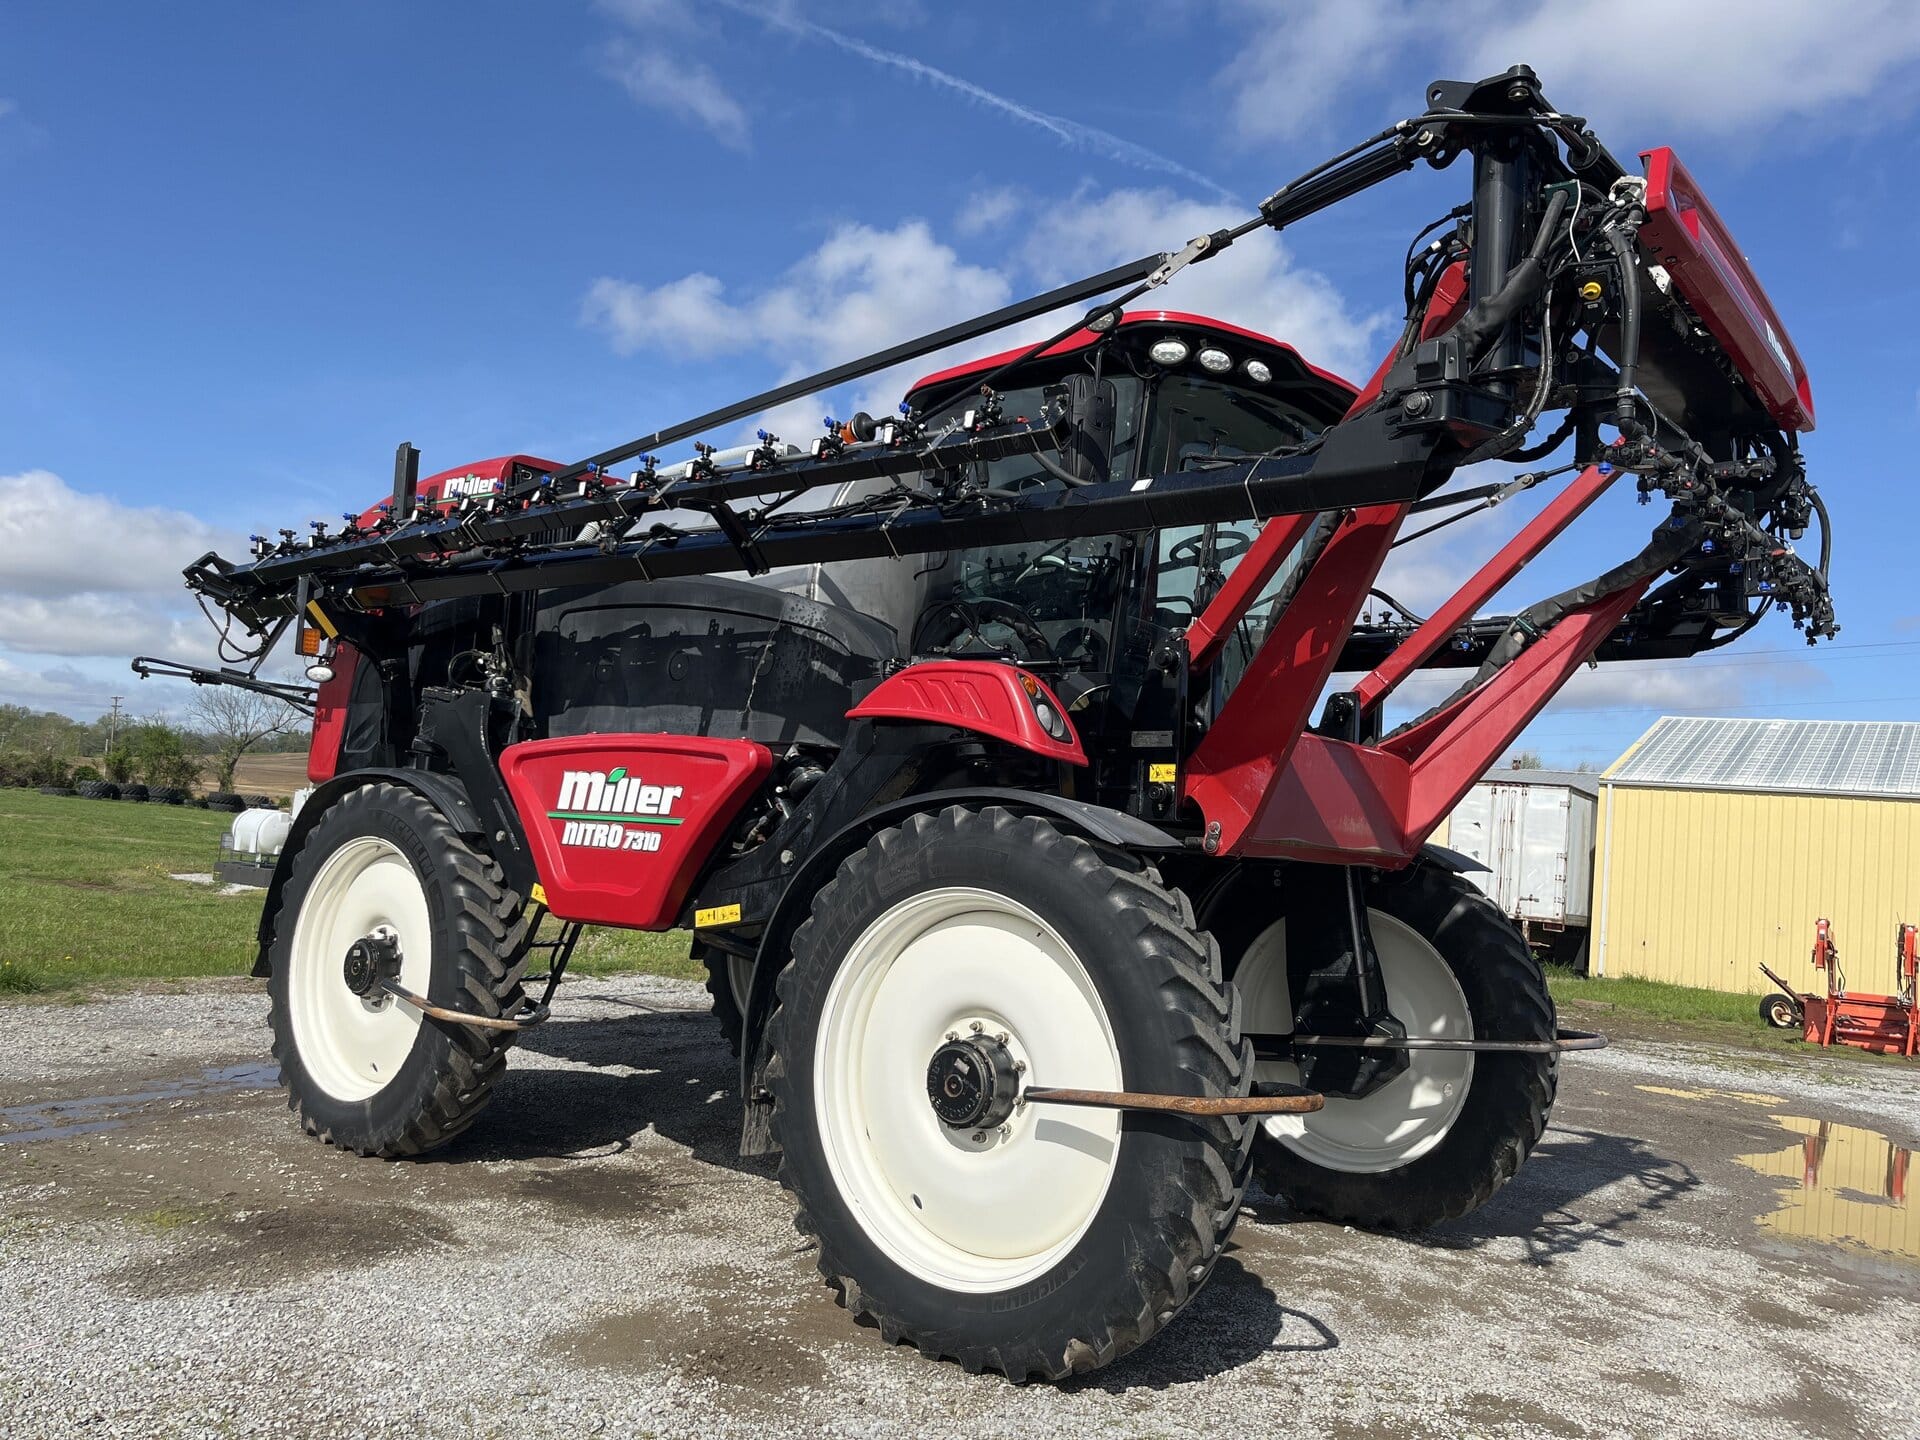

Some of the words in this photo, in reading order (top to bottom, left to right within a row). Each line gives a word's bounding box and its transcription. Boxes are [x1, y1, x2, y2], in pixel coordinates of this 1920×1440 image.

[443, 474, 498, 499] Miller
[556, 767, 684, 816] Miller
[561, 821, 624, 849] NITRO
